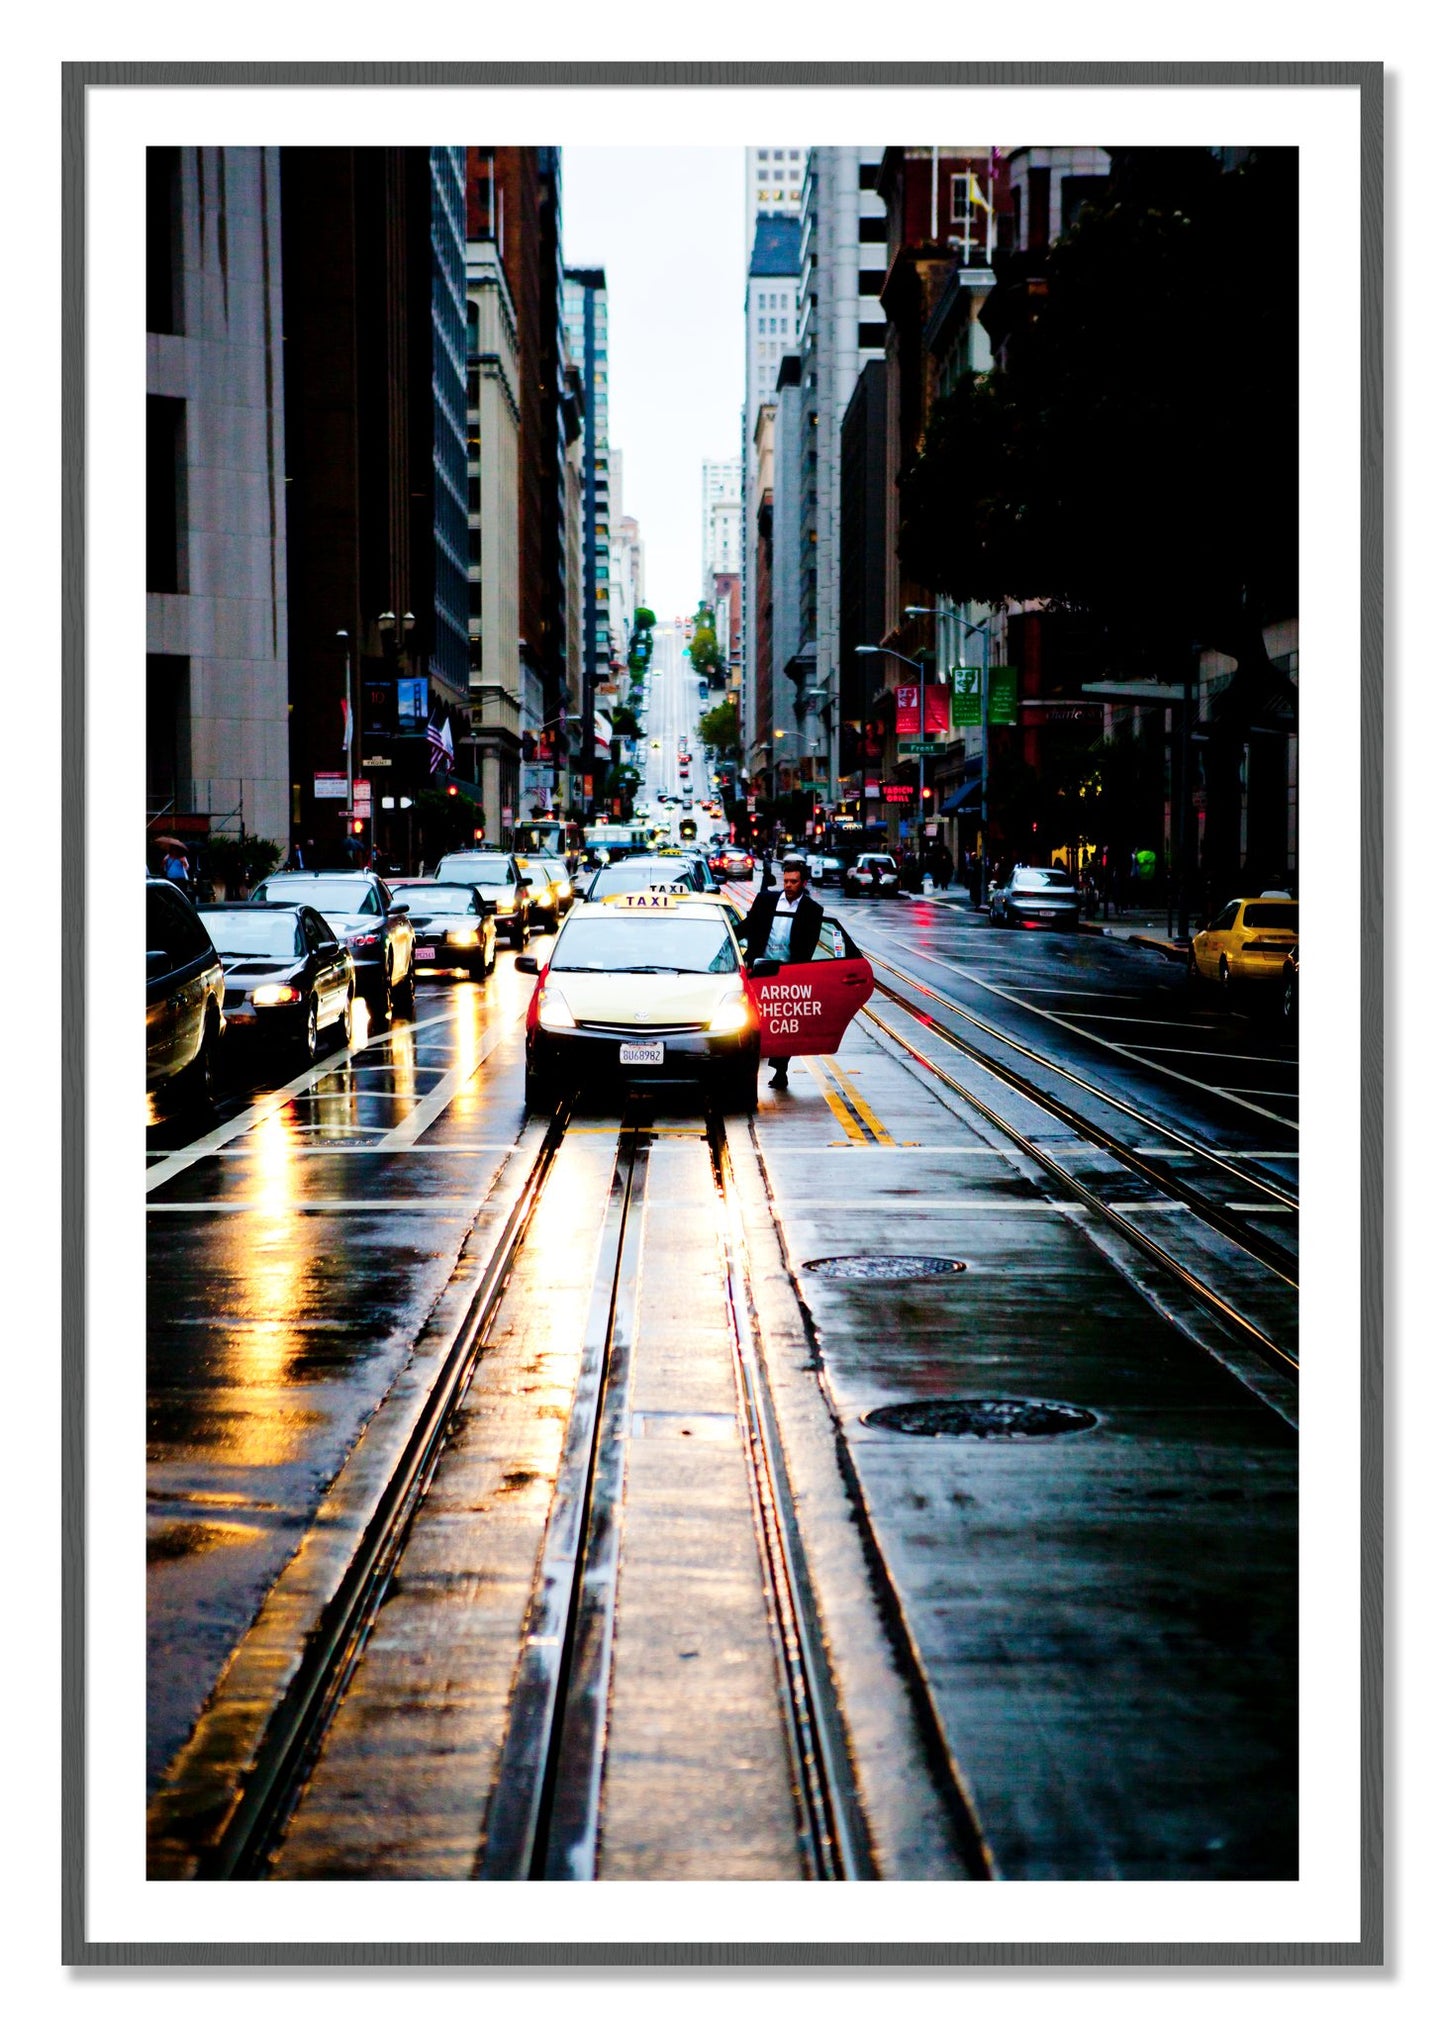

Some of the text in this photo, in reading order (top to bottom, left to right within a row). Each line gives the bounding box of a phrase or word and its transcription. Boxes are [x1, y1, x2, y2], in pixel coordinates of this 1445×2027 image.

[910, 744, 934, 752] Front
[882, 785, 914, 794] TADICH
[885, 795, 909, 803] GRILL
[650, 885, 684, 893] TAXI
[626, 896, 668, 906] TAXI
[760, 984, 812, 1000] ARROW
[769, 1019, 799, 1034] CAB
